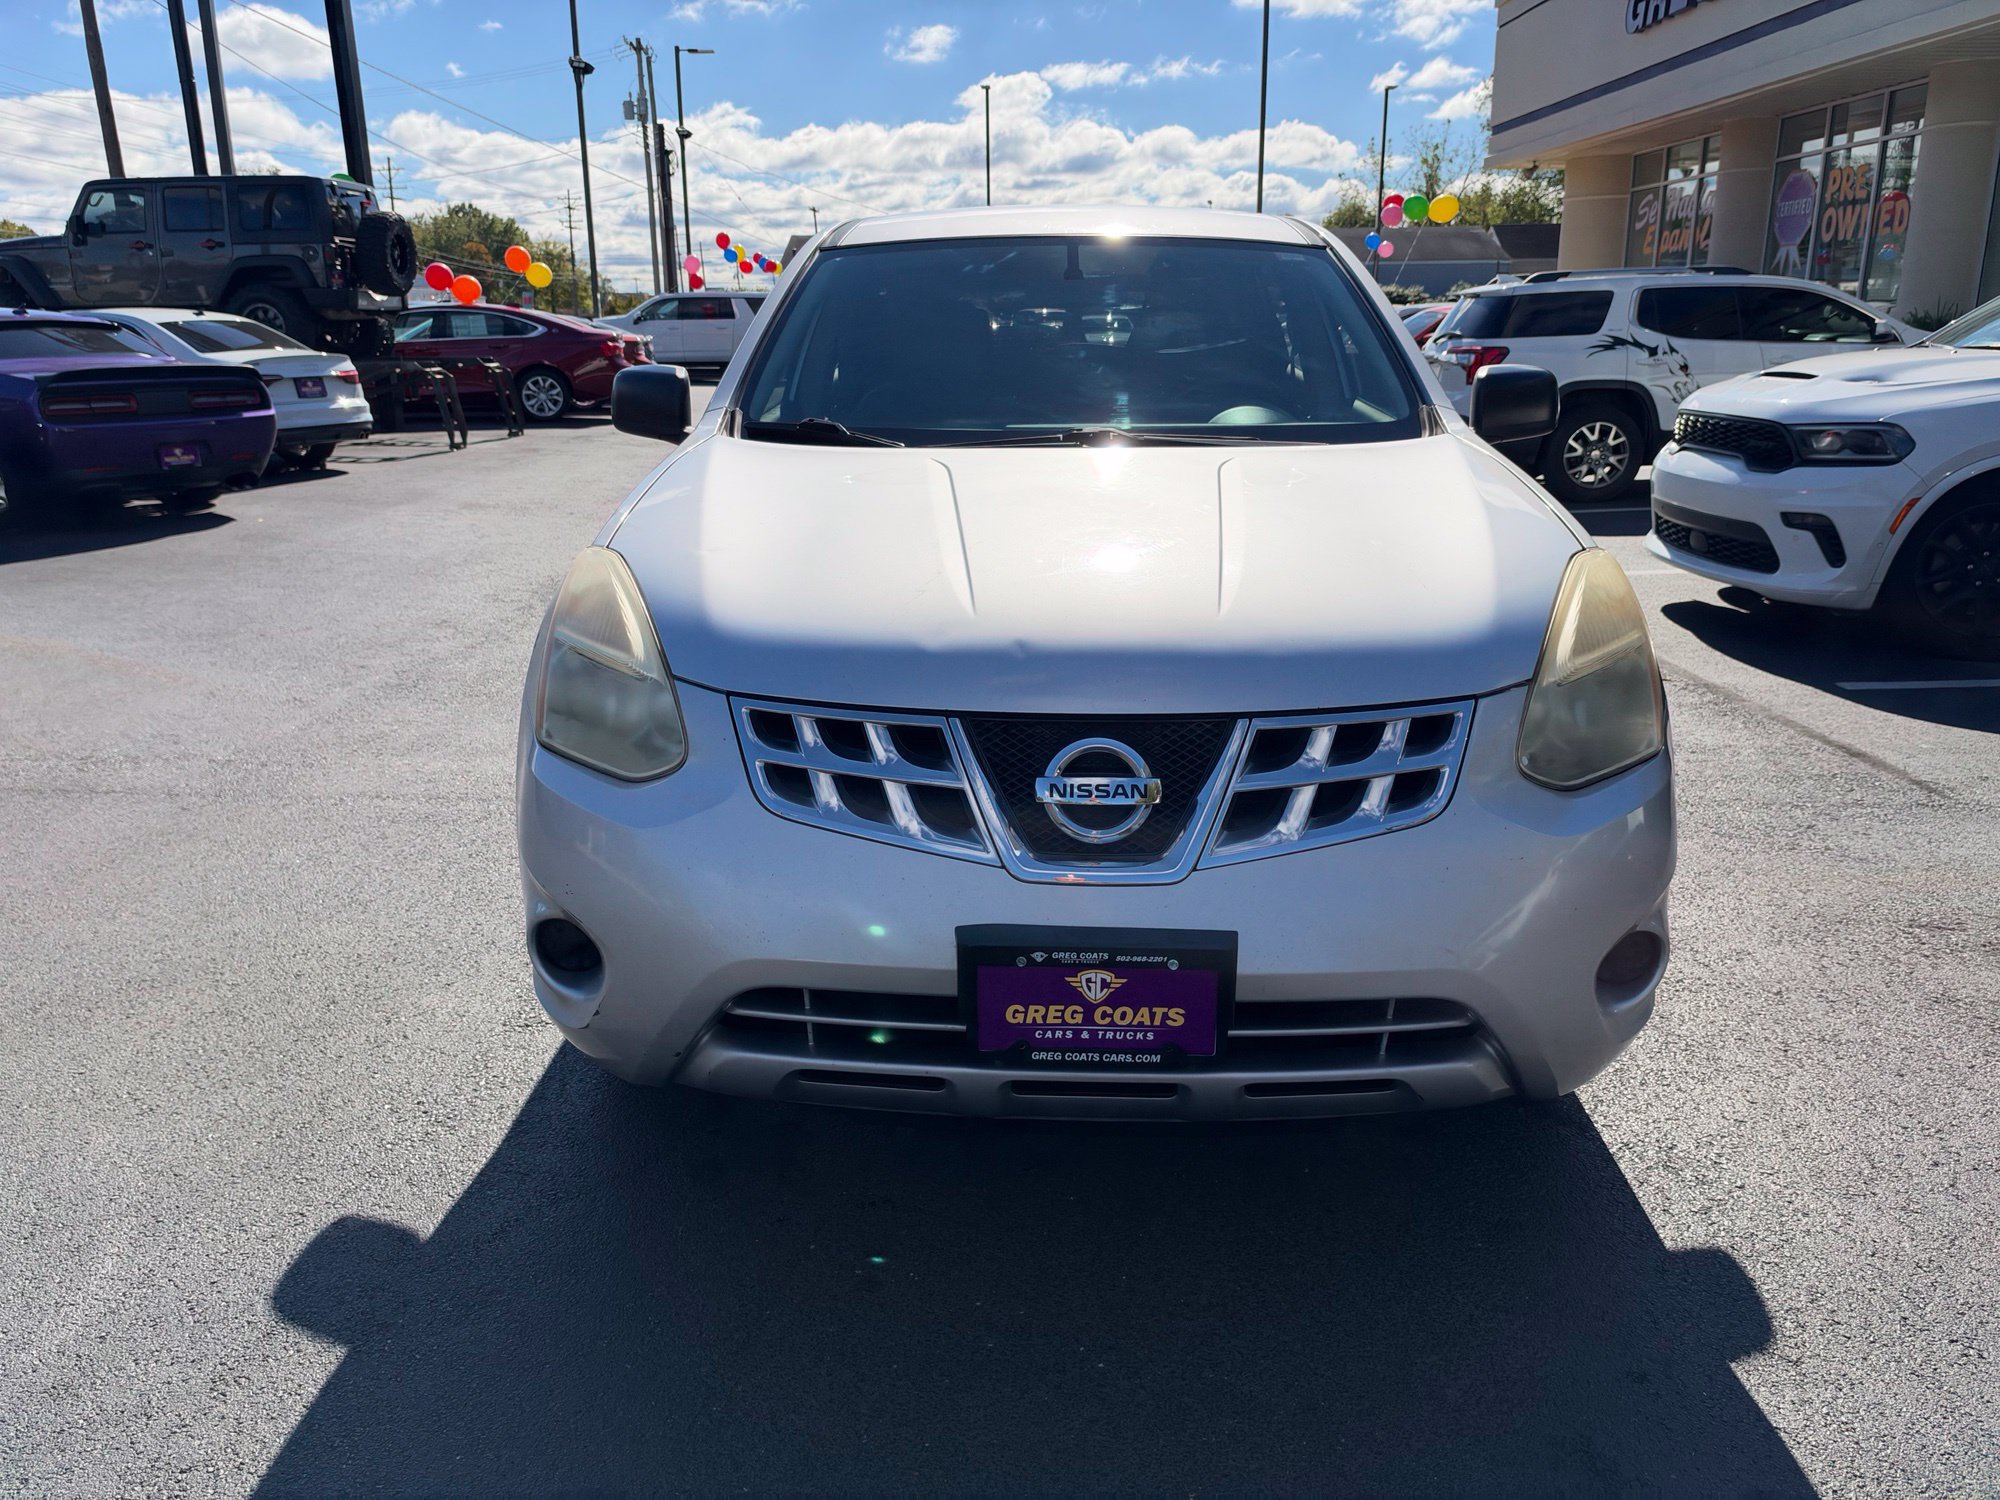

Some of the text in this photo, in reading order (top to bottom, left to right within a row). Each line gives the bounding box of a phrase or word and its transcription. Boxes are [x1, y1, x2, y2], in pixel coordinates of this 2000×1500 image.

[1776, 197, 1812, 217] CERTIFIED
[1821, 198, 1909, 242] OWNED
[1049, 783, 1148, 799] NISSAN
[1080, 952, 1109, 960] COATS
[1005, 1004, 1186, 1027] GREG COATS
[1035, 1030, 1155, 1041] CARS & TRUCKS
[1031, 1051, 1161, 1063] GREG COATS CARS.COM
